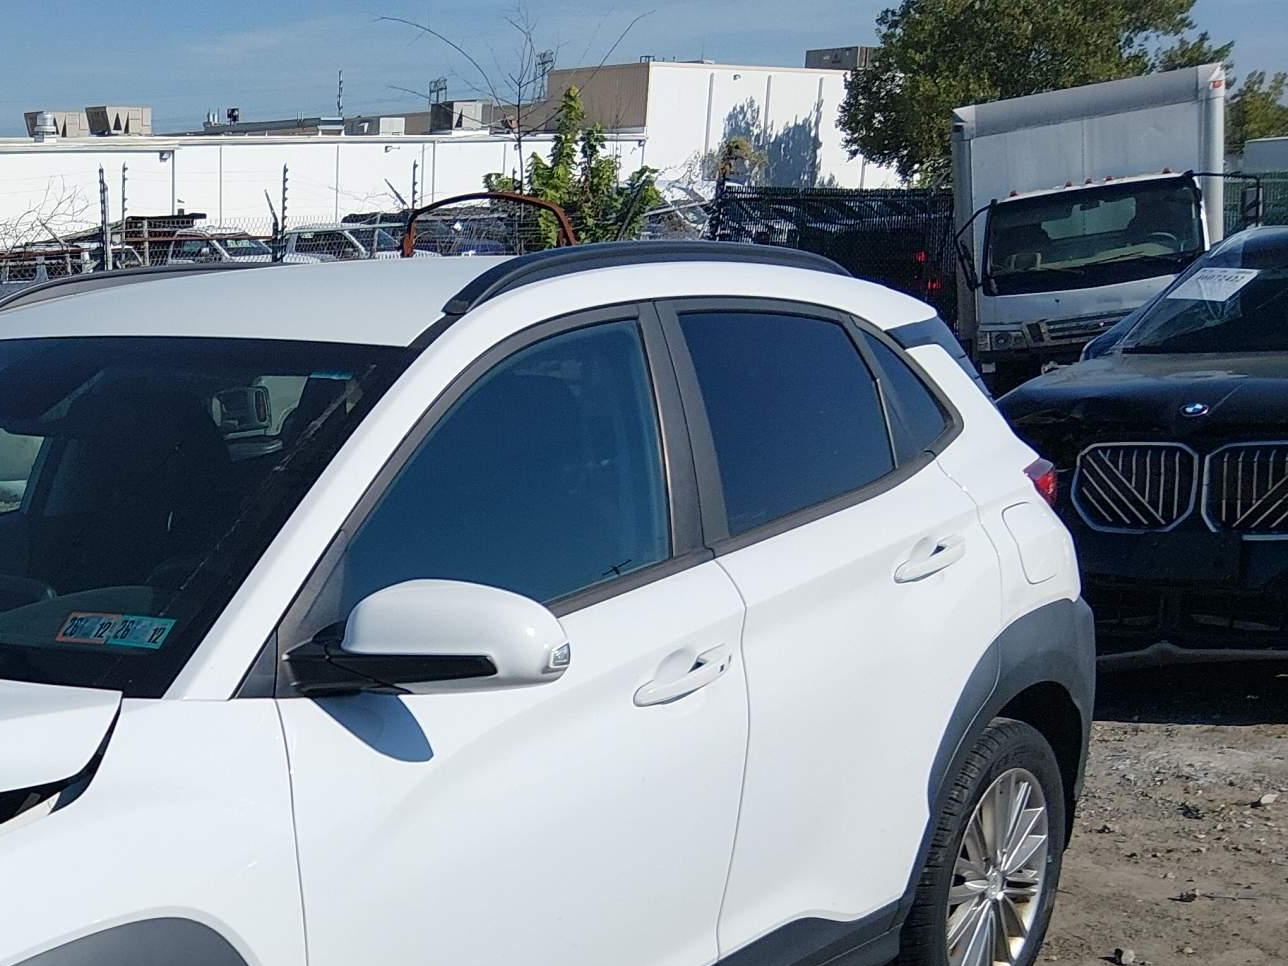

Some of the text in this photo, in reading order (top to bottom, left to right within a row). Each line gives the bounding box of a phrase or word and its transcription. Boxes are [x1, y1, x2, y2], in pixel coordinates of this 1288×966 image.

[94, 621, 112, 638] 12
[112, 619, 166, 644] 26 12
